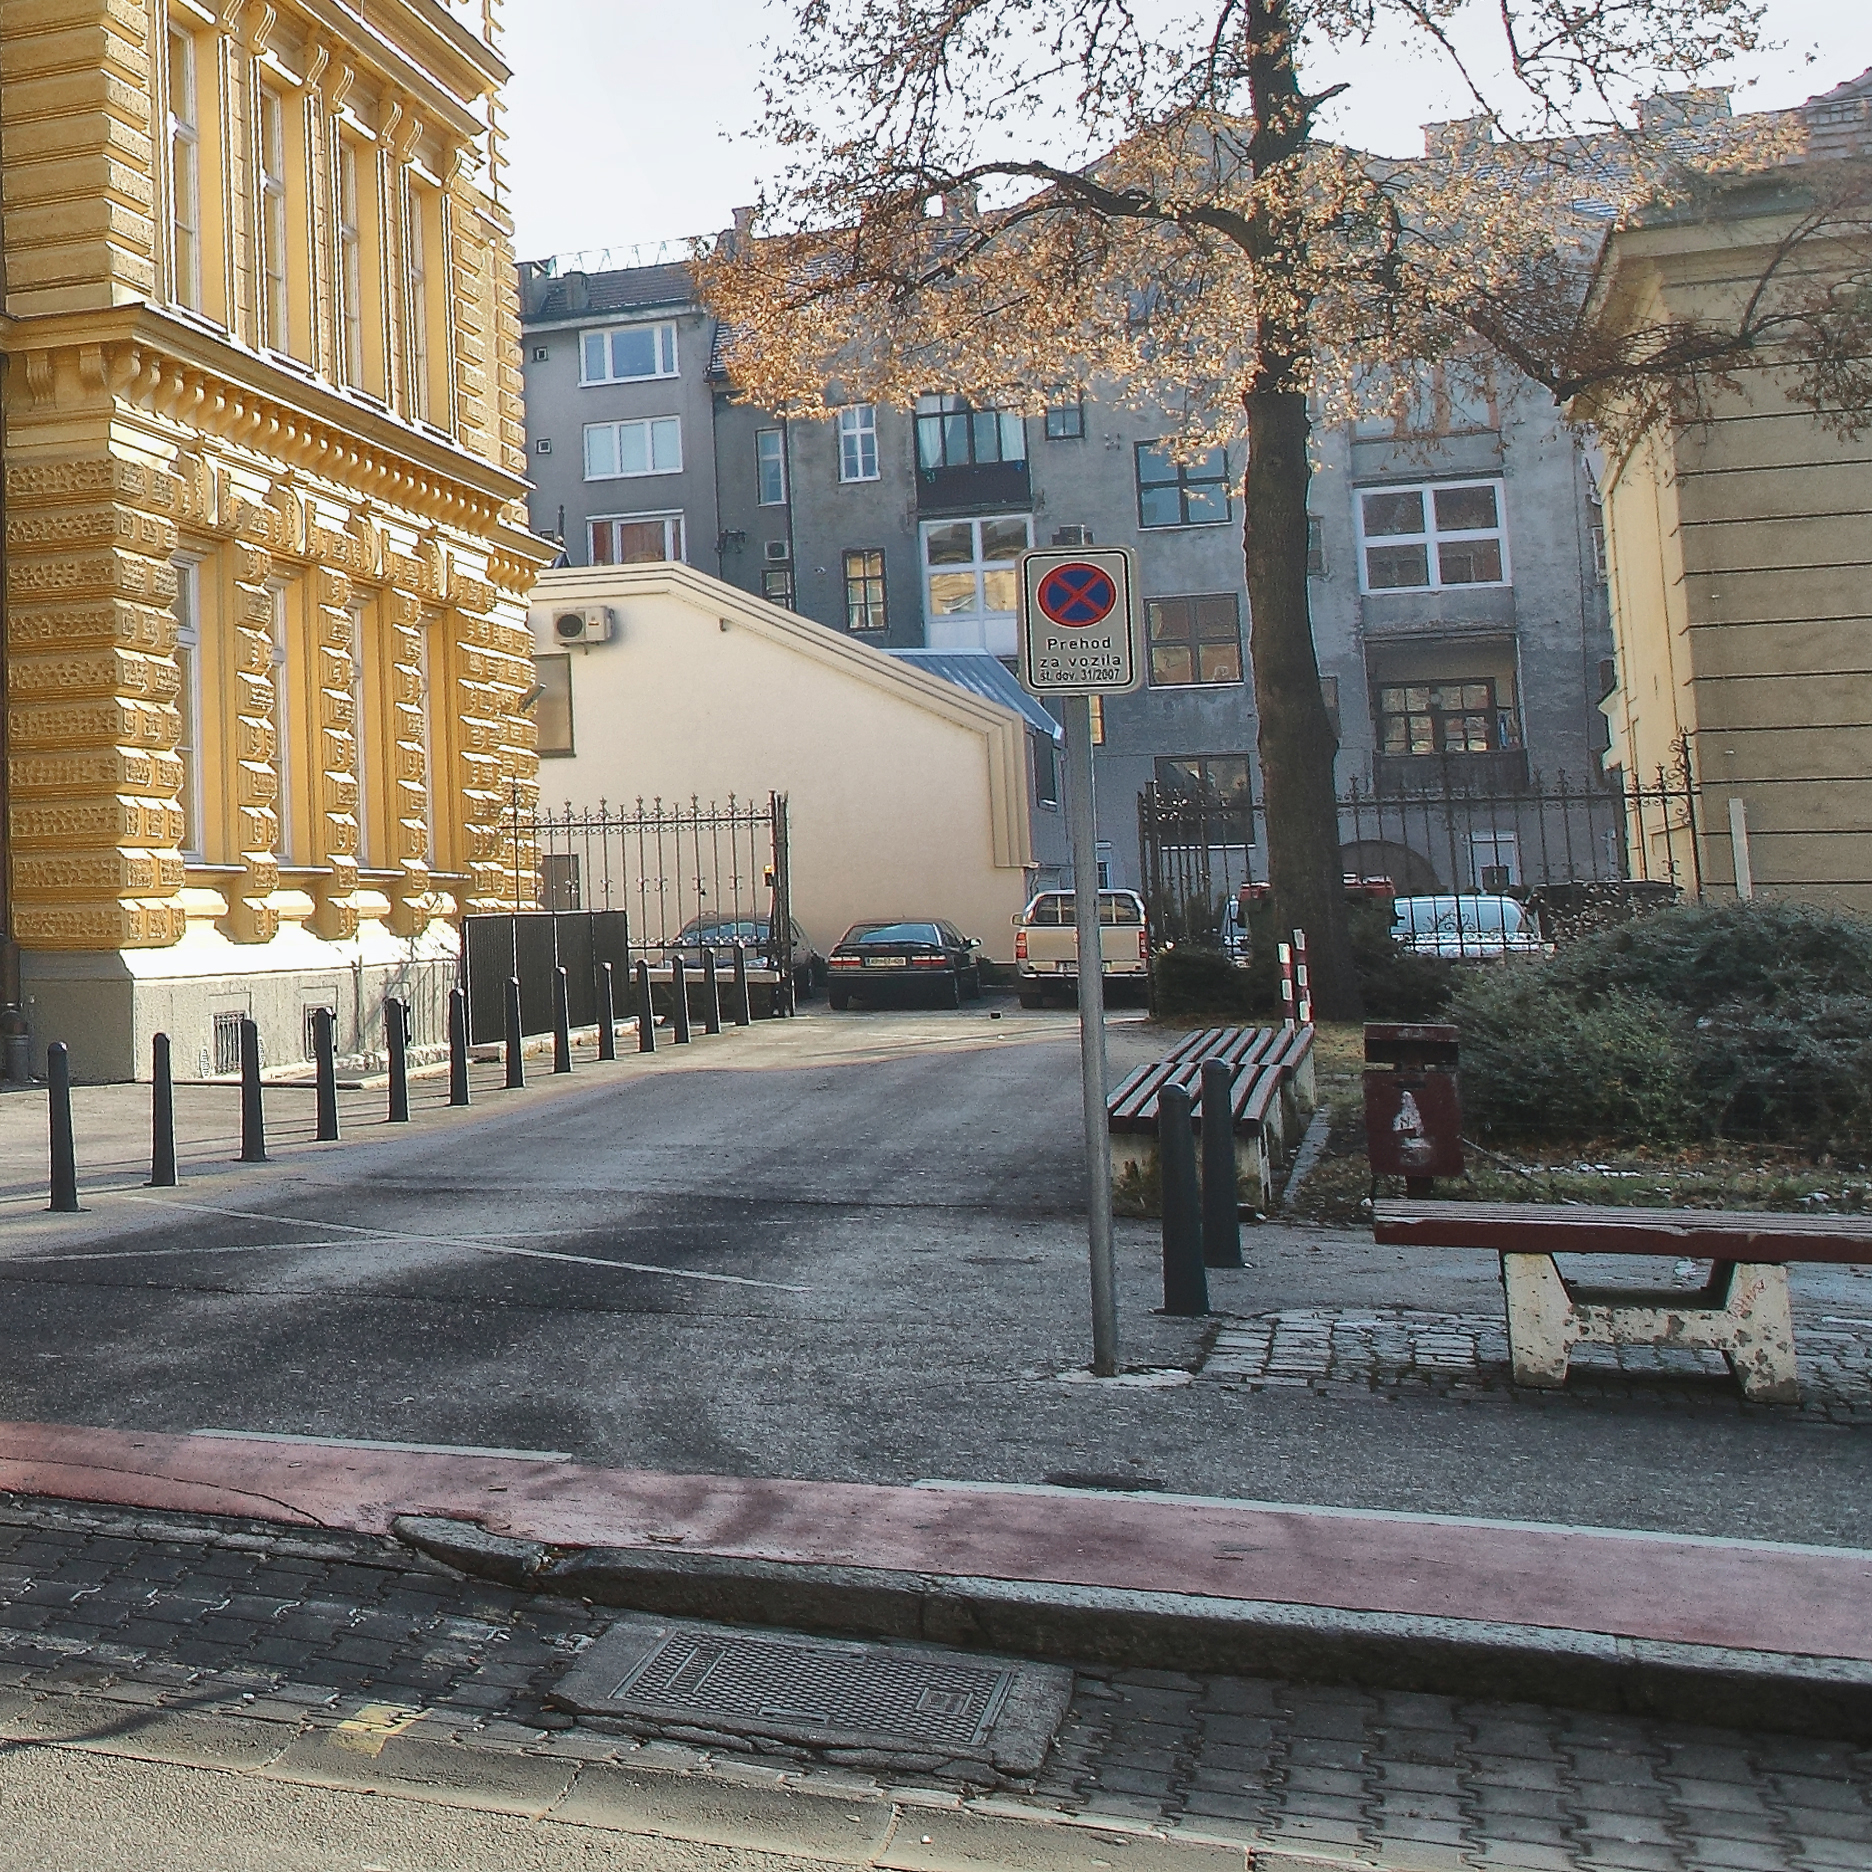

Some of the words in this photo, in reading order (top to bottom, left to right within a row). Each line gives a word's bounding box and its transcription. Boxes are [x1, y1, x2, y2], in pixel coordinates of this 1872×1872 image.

[1047, 636, 1111, 650] Prehod
[1039, 658, 1060, 668] za
[1068, 653, 1121, 667] vozila
